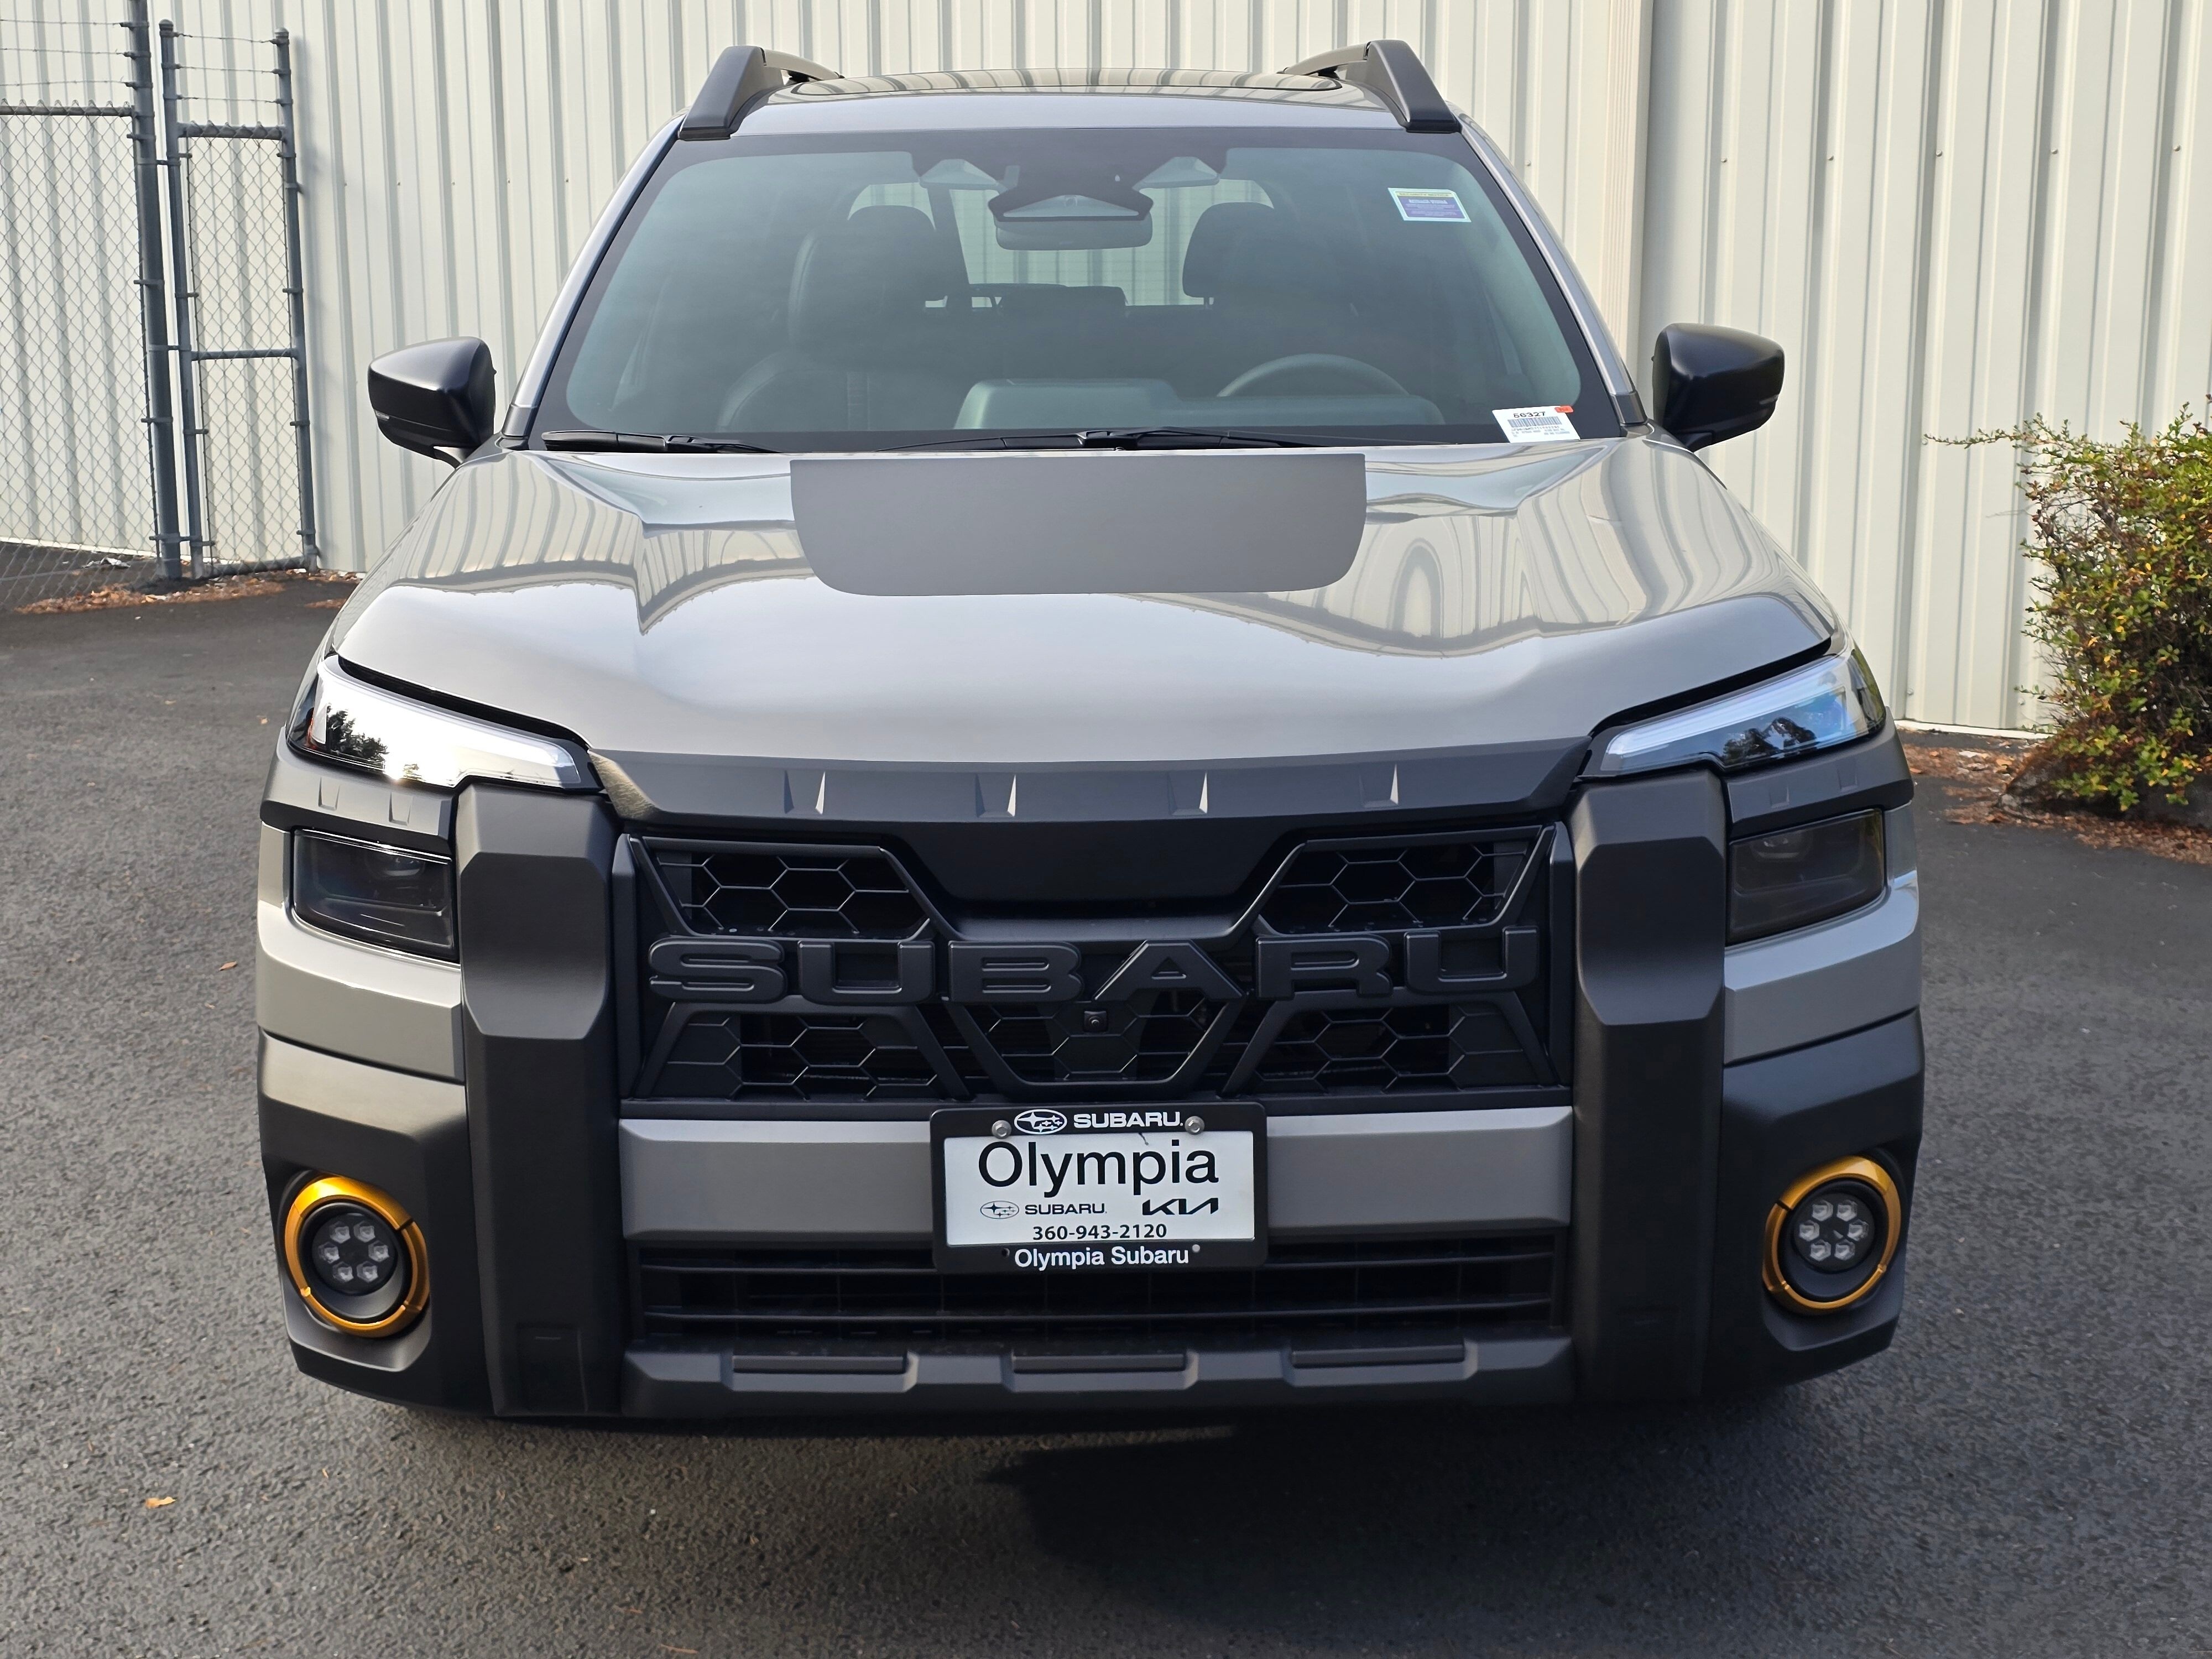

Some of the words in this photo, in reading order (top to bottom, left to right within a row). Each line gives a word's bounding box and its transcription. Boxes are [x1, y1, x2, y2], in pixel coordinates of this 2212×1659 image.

[648, 926, 1539, 1005] SUBARU
[1073, 1112, 1180, 1128] SUBARU
[978, 1139, 1219, 1198] Olympia
[1025, 1203, 1105, 1215] SUBARU
[1032, 1223, 1167, 1240] 360-943-2120
[1015, 1247, 1105, 1271] Olympia
[1111, 1246, 1189, 1265] Subaru
